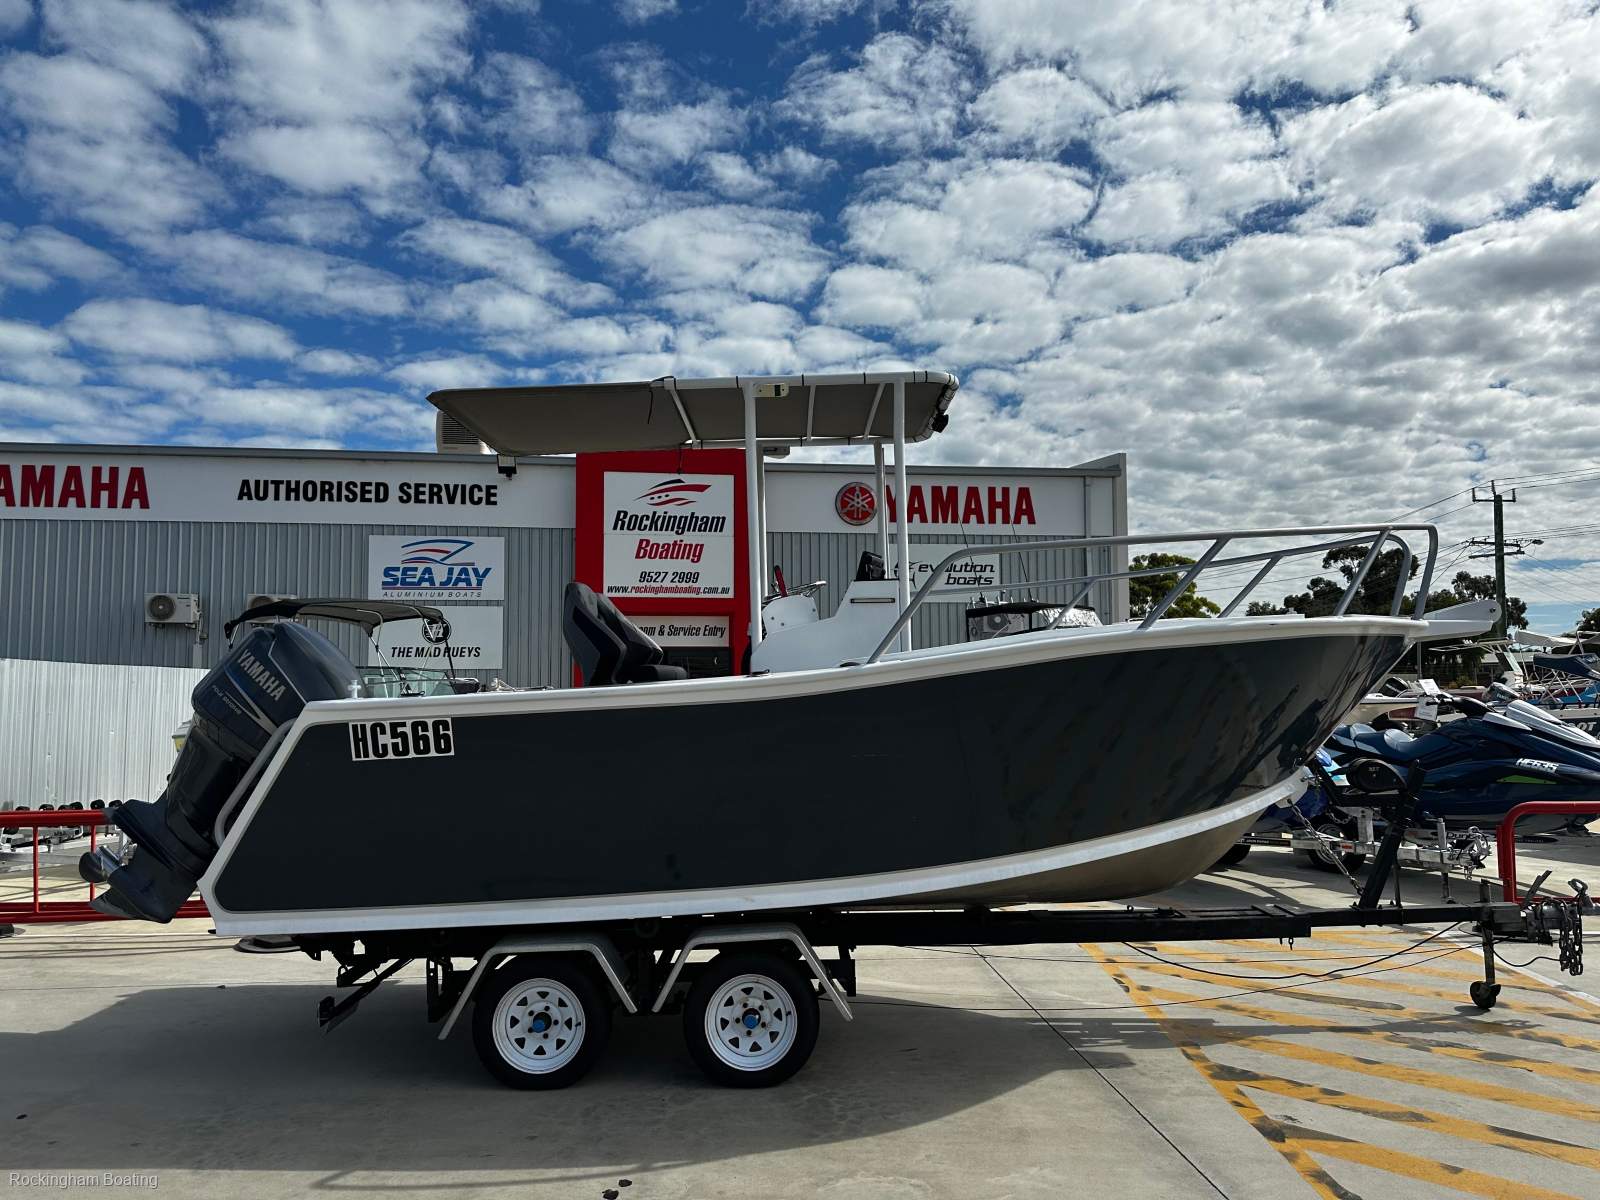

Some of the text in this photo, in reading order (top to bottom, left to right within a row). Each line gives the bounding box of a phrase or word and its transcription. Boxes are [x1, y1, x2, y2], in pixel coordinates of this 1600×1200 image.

[237, 479, 498, 506] AUTHORISED SERVICE
[612, 510, 727, 535] Rockingham
[635, 538, 705, 563] Boating
[918, 562, 995, 573] evlution
[382, 566, 492, 587] SEA JAY
[638, 571, 700, 584] 9527 2999
[944, 573, 994, 585] boats
[607, 585, 730, 595] www.rockinghamboating.com.au
[658, 625, 665, 637] &
[667, 625, 700, 637] Service
[703, 625, 726, 638] Entry
[391, 646, 413, 658] THE
[443, 646, 481, 658] HUEYS
[237, 649, 286, 701] YAMAHA
[351, 719, 452, 758] HC566
